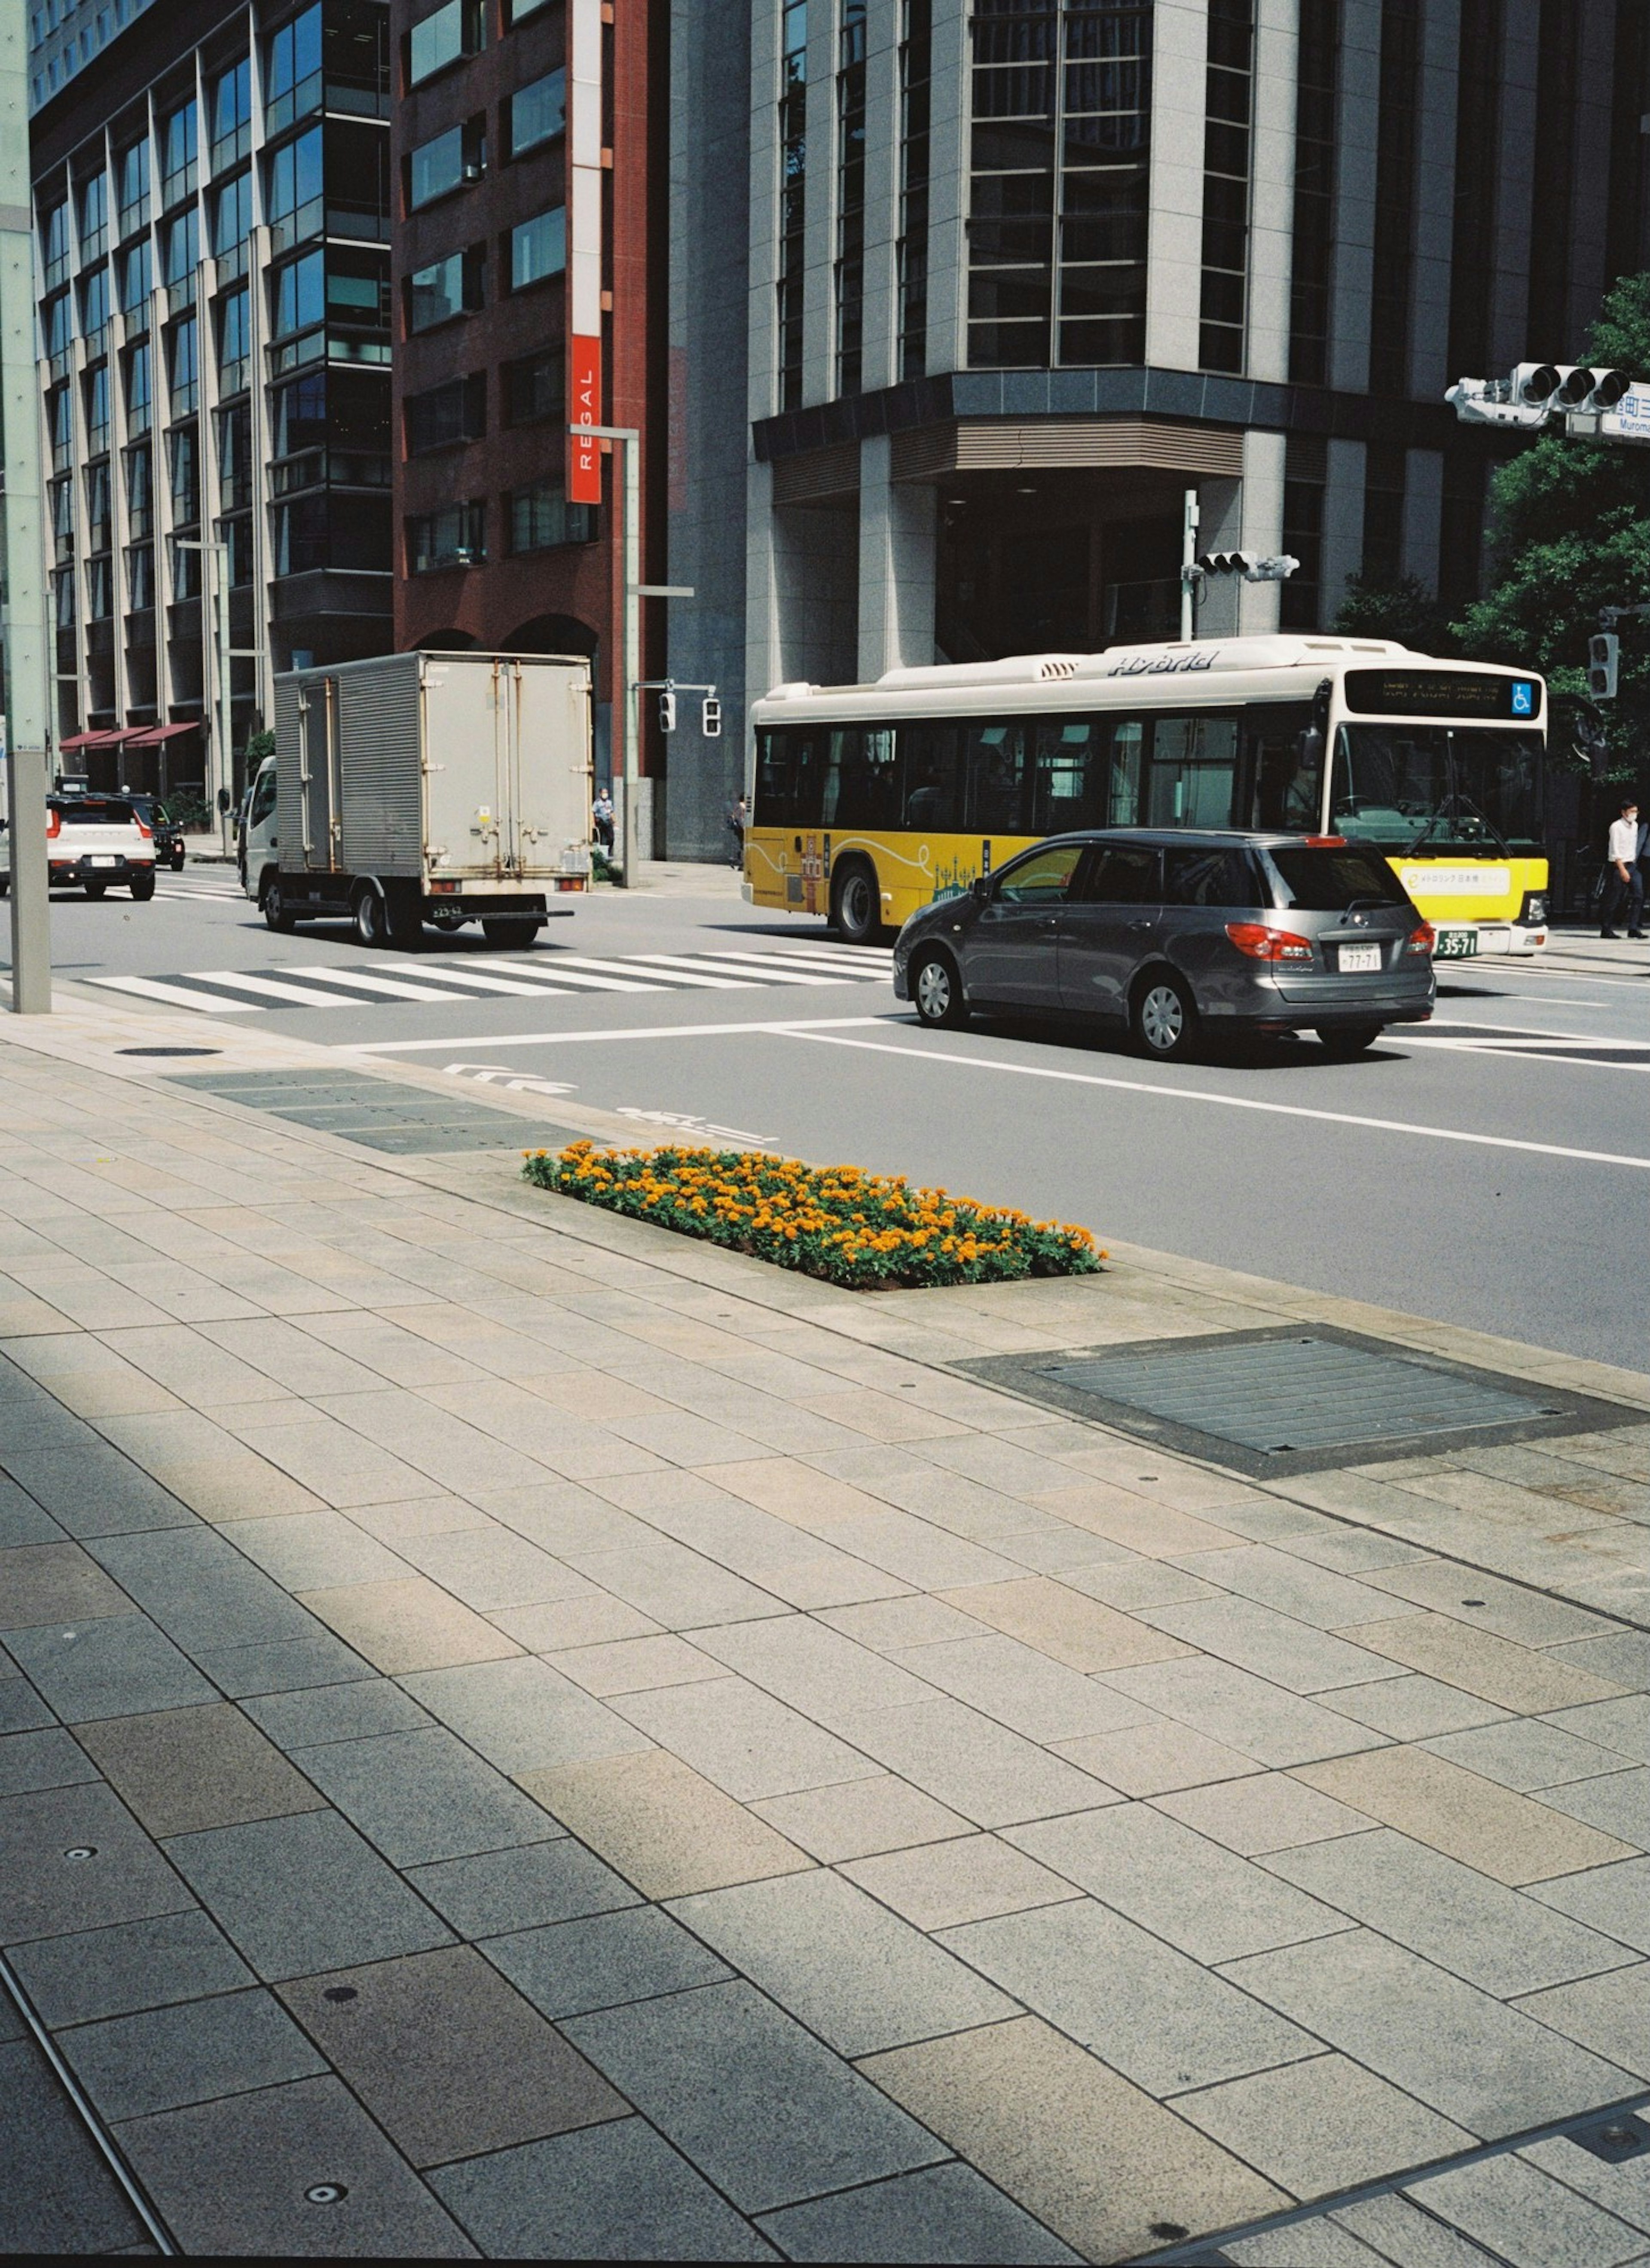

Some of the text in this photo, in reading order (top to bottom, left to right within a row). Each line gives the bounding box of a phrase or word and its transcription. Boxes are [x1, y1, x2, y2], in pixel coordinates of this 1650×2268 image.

[580, 370, 592, 470] REGAL
[1108, 650, 1219, 677] Hybrid
[1444, 938, 1475, 955] 35-71
[1349, 954, 1377, 968] 77-71
